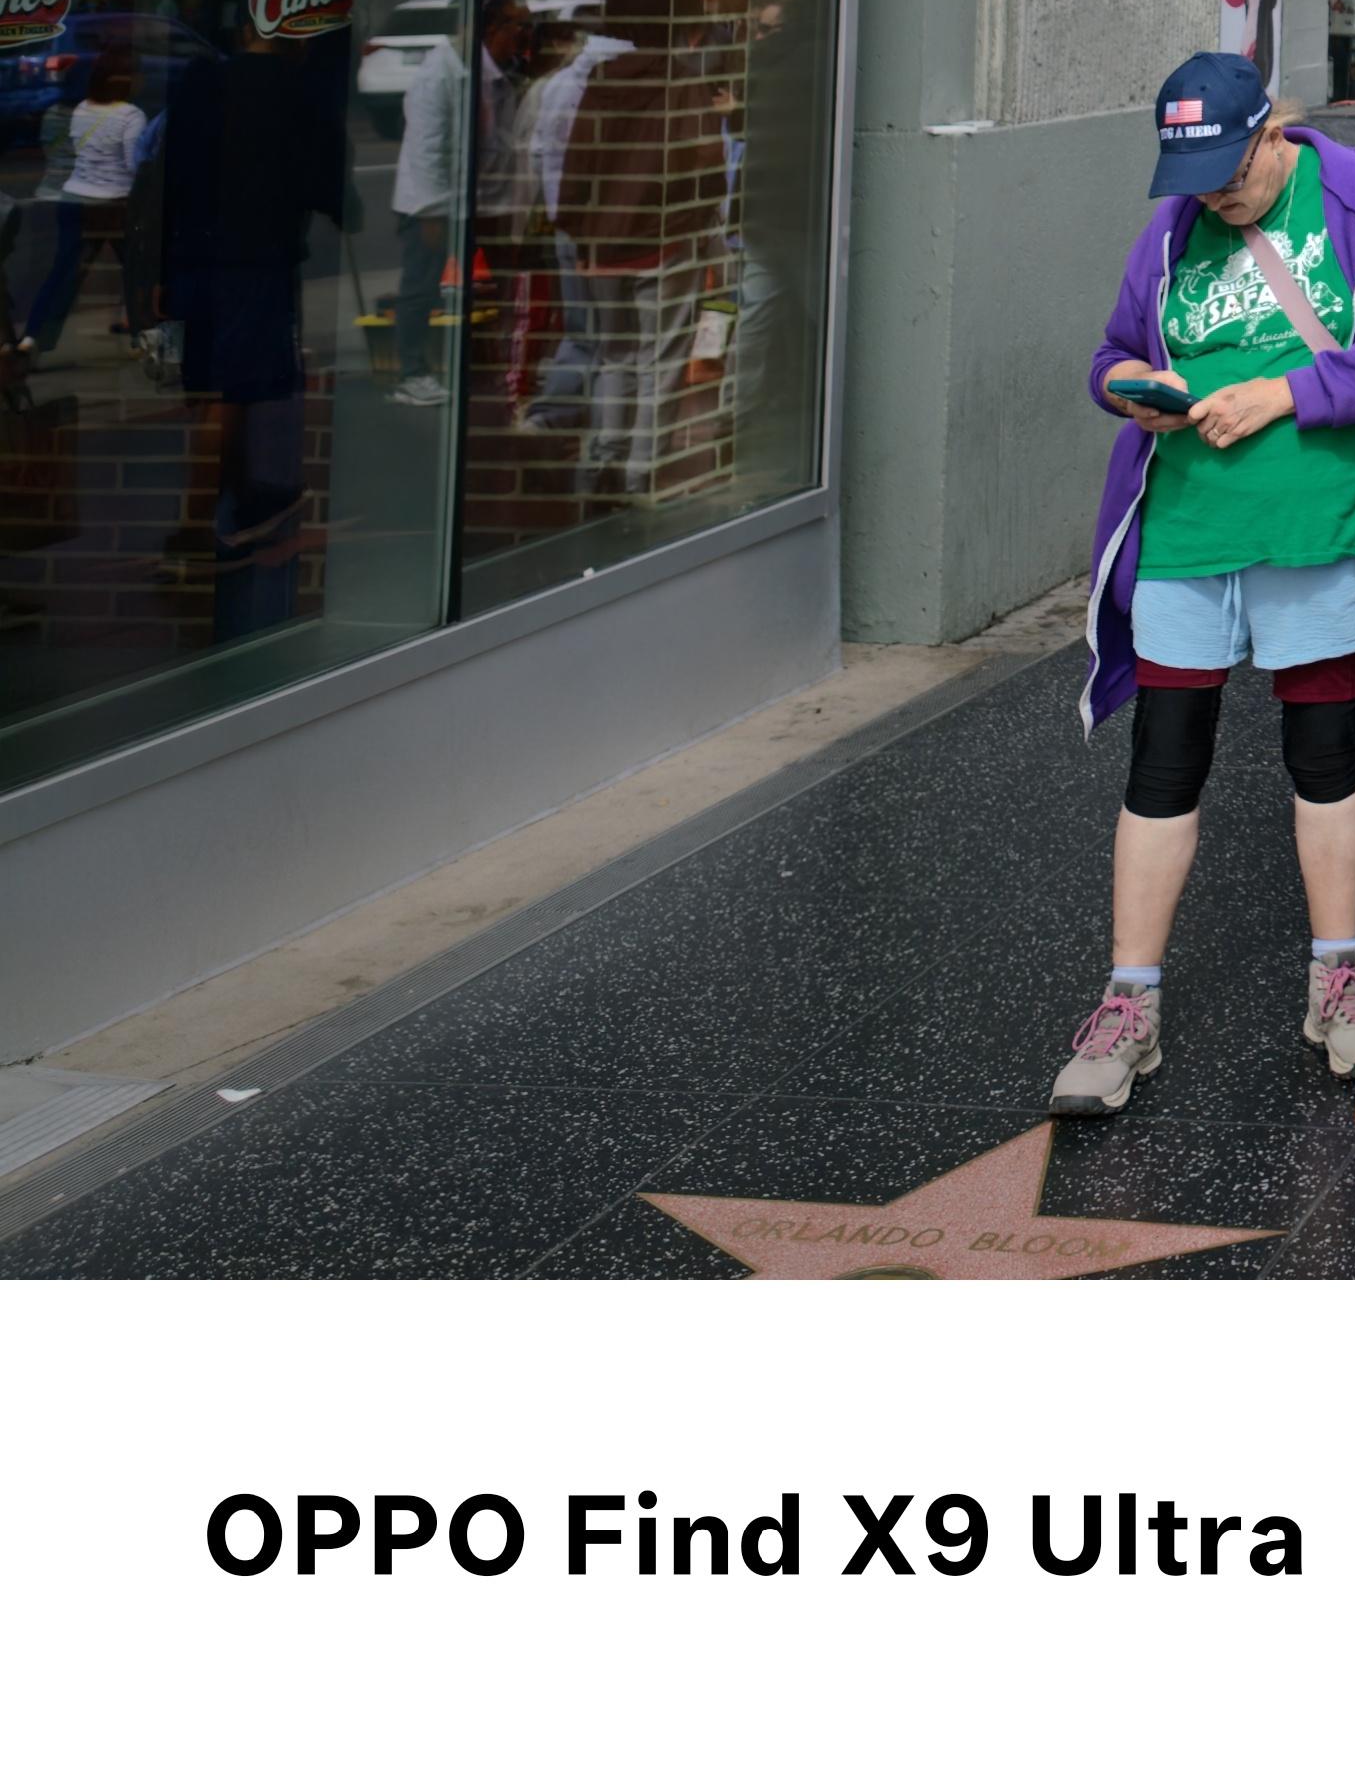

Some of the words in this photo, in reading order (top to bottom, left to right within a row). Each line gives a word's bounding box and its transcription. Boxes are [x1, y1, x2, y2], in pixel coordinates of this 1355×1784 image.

[1175, 127, 1184, 139] A
[1185, 123, 1222, 139] HERO
[1209, 282, 1279, 325] SAFA
[731, 1218, 946, 1249] ORLANDO
[967, 1230, 1132, 1259] BLOOM
